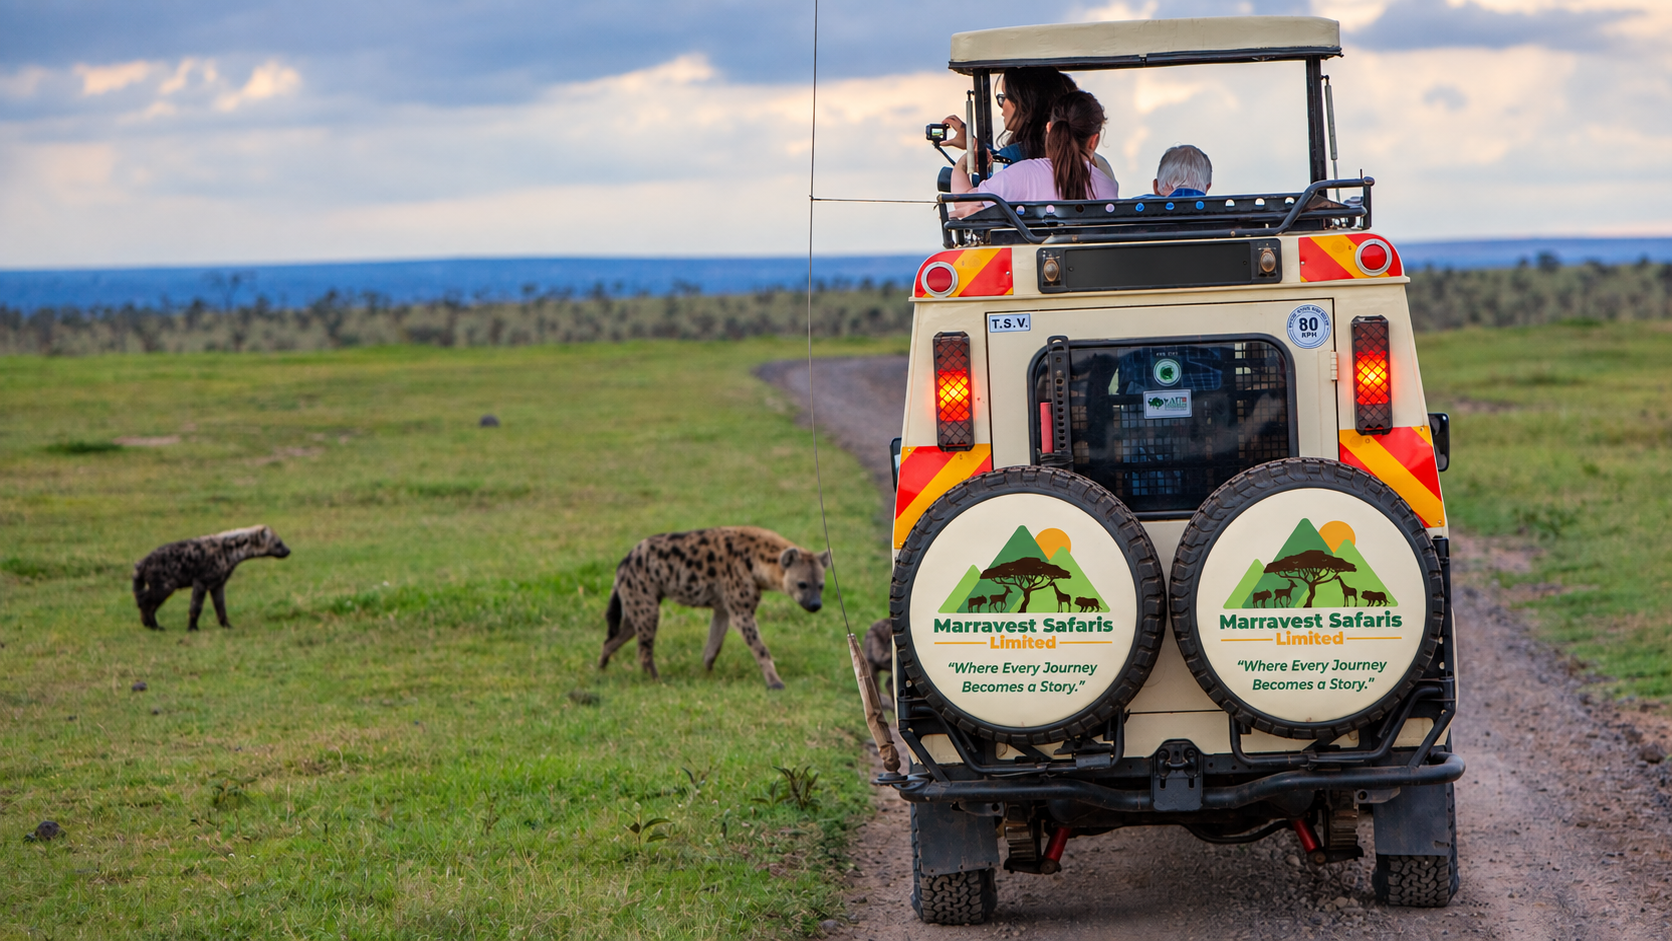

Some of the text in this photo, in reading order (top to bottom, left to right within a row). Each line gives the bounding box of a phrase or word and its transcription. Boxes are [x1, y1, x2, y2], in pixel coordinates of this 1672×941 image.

[992, 317, 1028, 329] T.S.V.
[1299, 317, 1318, 331] 80
[934, 616, 1113, 633] Marravest Safaris
[1219, 610, 1403, 630] Marravest Safaris
[990, 635, 1056, 649] Limited
[1276, 630, 1344, 646] Limited
[1002, 662, 1040, 676] Every
[1043, 662, 1098, 676] Journey
[1291, 660, 1329, 674] Every
[1332, 659, 1387, 673] Journey
[962, 681, 1024, 693] Becomes
[1028, 683, 1036, 693] a
[1252, 679, 1314, 691] Becomes
[1317, 680, 1326, 690] a
